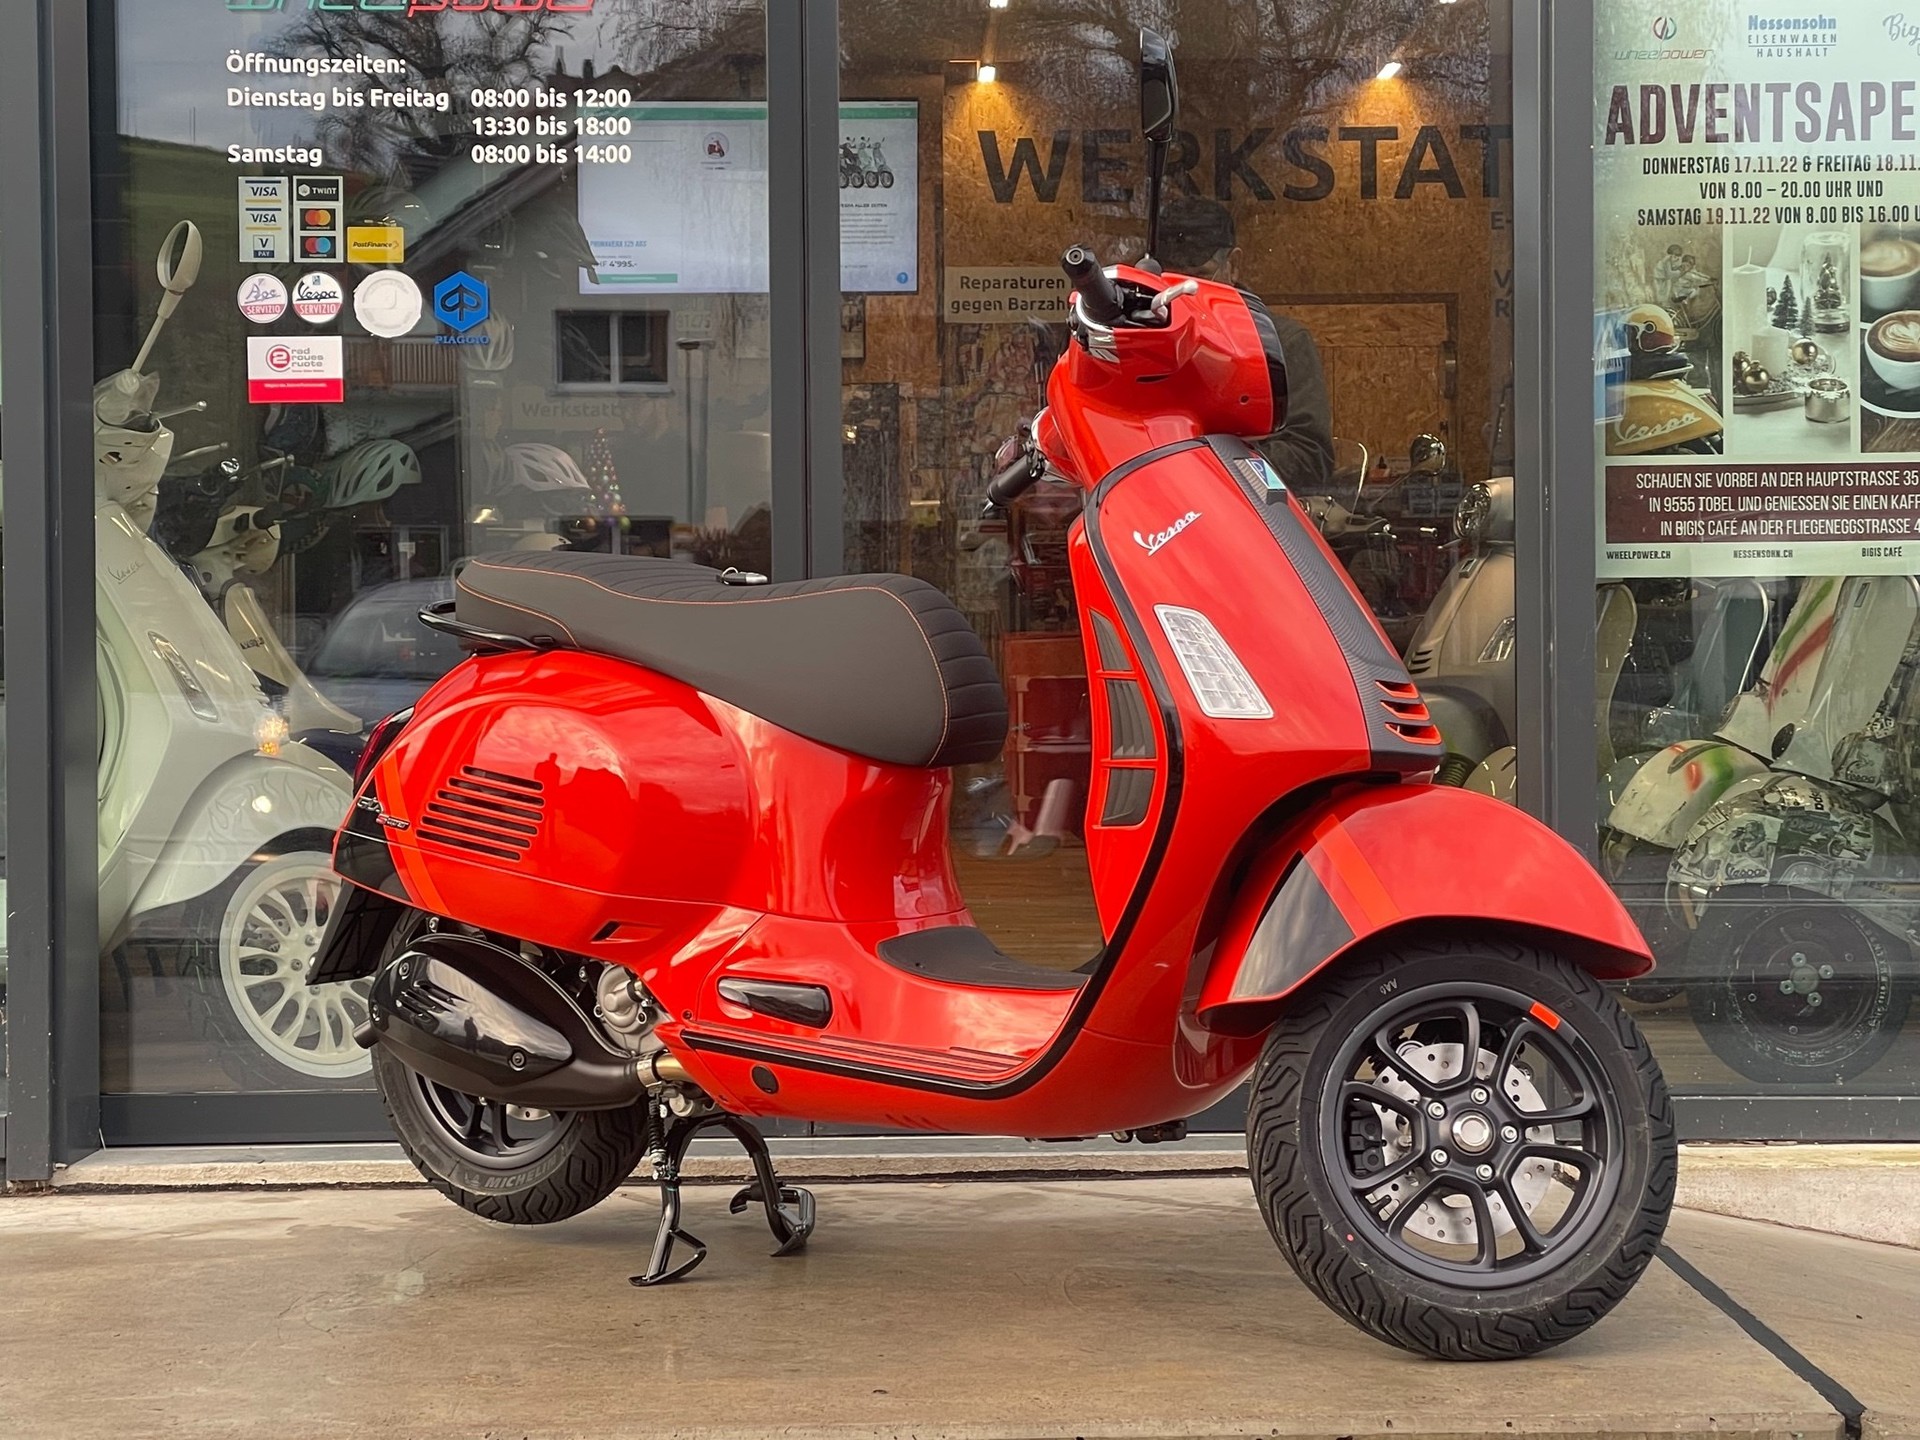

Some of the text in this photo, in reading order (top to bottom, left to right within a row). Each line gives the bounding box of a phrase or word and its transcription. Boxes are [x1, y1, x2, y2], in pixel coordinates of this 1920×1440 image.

[1748, 15, 1837, 30] Nessensohn
[1748, 34, 1837, 44] EISENWAREN
[1757, 47, 1828, 58] HAUSHALT
[226, 50, 406, 76] Öffnungszeiten:
[227, 88, 632, 110] Dienstag bis Freitag 08:00 bis 12:00
[1604, 81, 1916, 145] ADVENTSAPE
[471, 116, 632, 136] 13:30 bis 18:00
[227, 144, 632, 166] Samstag 08:00 bis 14:00
[1643, 156, 1730, 175] DONNERSTAG
[1734, 155, 1798, 174] 17.11.22
[1802, 155, 1812, 173] &
[1817, 154, 1872, 173] FREITAG
[250, 186, 278, 197] VISA
[312, 187, 337, 195] TWINT
[1699, 182, 1726, 199] VON
[1731, 182, 1762, 199] 8.00
[1781, 181, 1821, 198] 20.00
[1825, 181, 1852, 198] UHR
[1857, 180, 1884, 197] UND
[250, 213, 277, 223] VISA
[1638, 208, 1701, 226] SAMSTAG
[1705, 207, 1770, 225] 19.11.22
[1775, 207, 1801, 224] VON
[1806, 206, 1837, 223] 8.00
[1842, 206, 1864, 223] BIS
[1868, 205, 1909, 223] 16.00
[258, 237, 269, 248] V
[295, 280, 339, 302] Vespa
[960, 276, 1065, 292] Reparaturen
[247, 305, 281, 315] SERVIZIO
[299, 304, 337, 314] SERVIZIO
[951, 299, 1003, 314] gegen
[434, 335, 489, 345] PIAGGIO
[291, 347, 311, 355] rad
[291, 360, 323, 368] ruote
[1614, 411, 1702, 448] Vespa
[1636, 470, 1919, 489] SCHAUEN SIE VORBEI AN DER HAUPTSTRASSE 35
[1649, 494, 1920, 512] IN 9555 TOBEL UND GENIESSEN SIE EINEN KAFF
[1132, 510, 1203, 557] Vespa
[1660, 520, 1672, 536] IN
[1675, 520, 1705, 536] BIGIS
[1708, 517, 1738, 535] CAFÉ
[1740, 519, 1757, 535] AN
[1760, 519, 1783, 535] DER
[1786, 518, 1911, 535] FLIEGENEGGSTRASSE
[1606, 549, 1671, 560] WHEELPOWER.CH
[1733, 549, 1794, 559] NESSENSOHN.CH
[1861, 546, 1902, 557] BIGIS CAFÉ
[484, 1152, 557, 1189] MICHELIN
